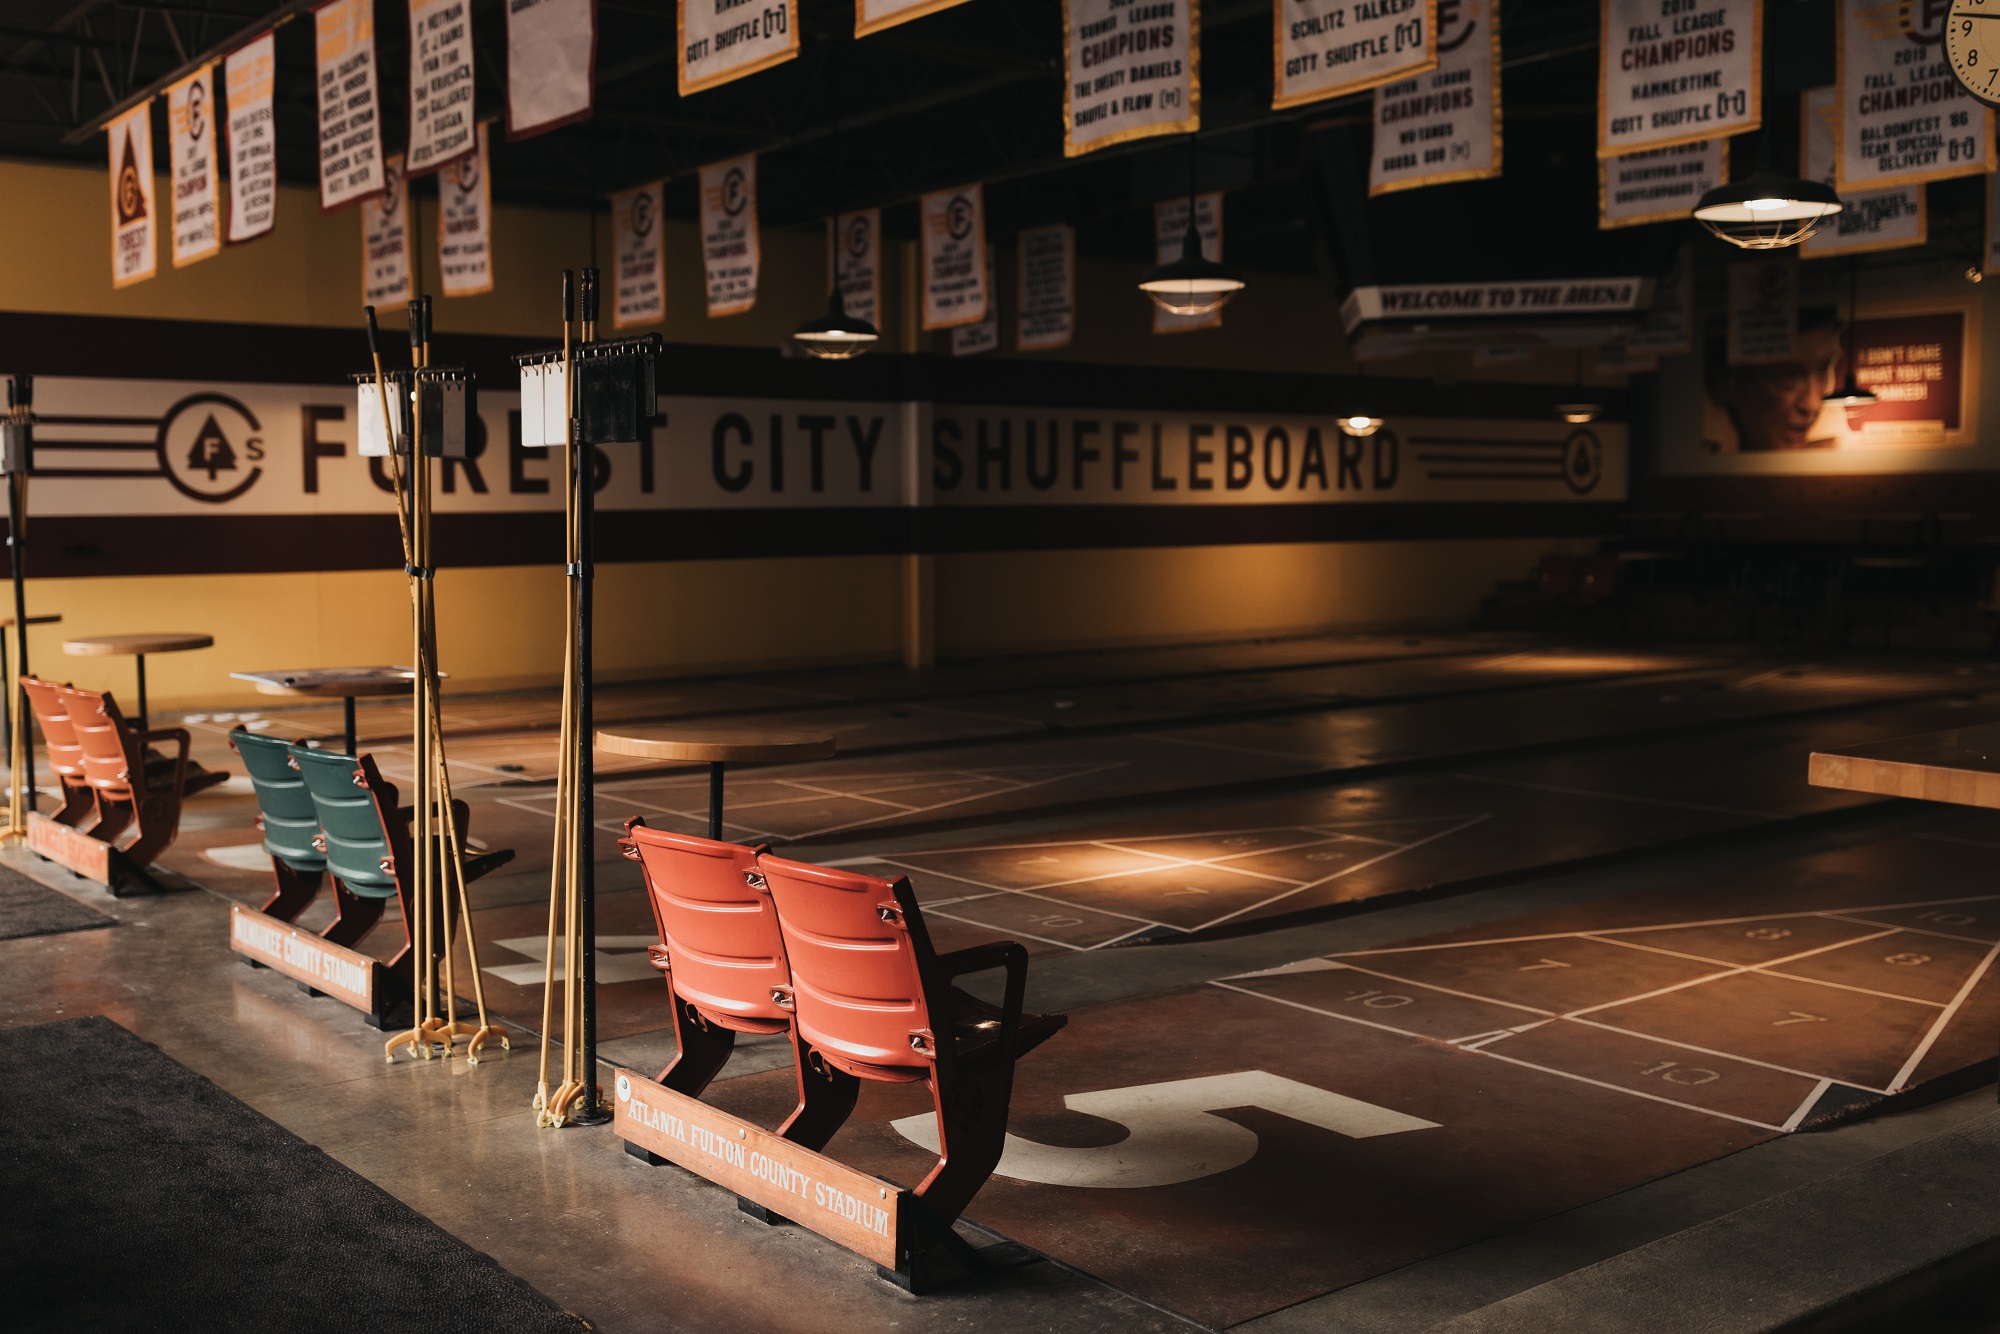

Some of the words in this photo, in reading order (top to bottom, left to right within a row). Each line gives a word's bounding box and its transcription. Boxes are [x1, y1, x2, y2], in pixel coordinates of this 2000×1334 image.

[1129, 4, 1174, 24] LEAGUE
[1291, 9, 1344, 40] SCHLITZ
[1629, 24, 1662, 42] FALL
[1673, 9, 1726, 36] LEAGUE
[1962, 20, 1972, 37] 9
[687, 37, 709, 63] GOTT
[715, 18, 760, 52] SHUFFLE
[1082, 25, 1175, 68] CHAMPIONS
[1621, 29, 1735, 71] CHAMPIONS
[1130, 60, 1182, 83] DANIELS
[1286, 54, 1319, 77] GOTT
[1326, 36, 1389, 68] SHUFFLE
[1967, 49, 1978, 66] 8
[1632, 71, 1722, 101] HAMMERTIME
[1864, 72, 1896, 89] FALL
[1909, 63, 1951, 83] LEAG
[1988, 69, 1999, 86] 7
[1074, 103, 1108, 126] SHUFFLE
[1111, 100, 1118, 115] &
[1122, 94, 1153, 113] FLOW
[1381, 87, 1474, 125] CHAMPIONS
[1611, 115, 1644, 135] GOTT
[1652, 104, 1712, 128] SHUFFLE
[1861, 141, 1890, 159] TEAM
[1896, 135, 1946, 156] SPECIAL
[1879, 149, 1938, 172] DELIVERY
[1381, 288, 1483, 311] WELCOME
[1489, 288, 1516, 307] TO
[1520, 286, 1564, 306] THE
[1565, 283, 1632, 305] ARENA
[246, 437, 265, 461] S
[712, 412, 885, 493] CITY
[932, 417, 1399, 491] SHUFFLEBOARD
[889, 1070, 1445, 1188] 5
[627, 1097, 687, 1142] ATLANTA
[690, 1123, 746, 1169] FULTON
[750, 1151, 811, 1199] COUNTY
[815, 1181, 890, 1238] STADIUM
